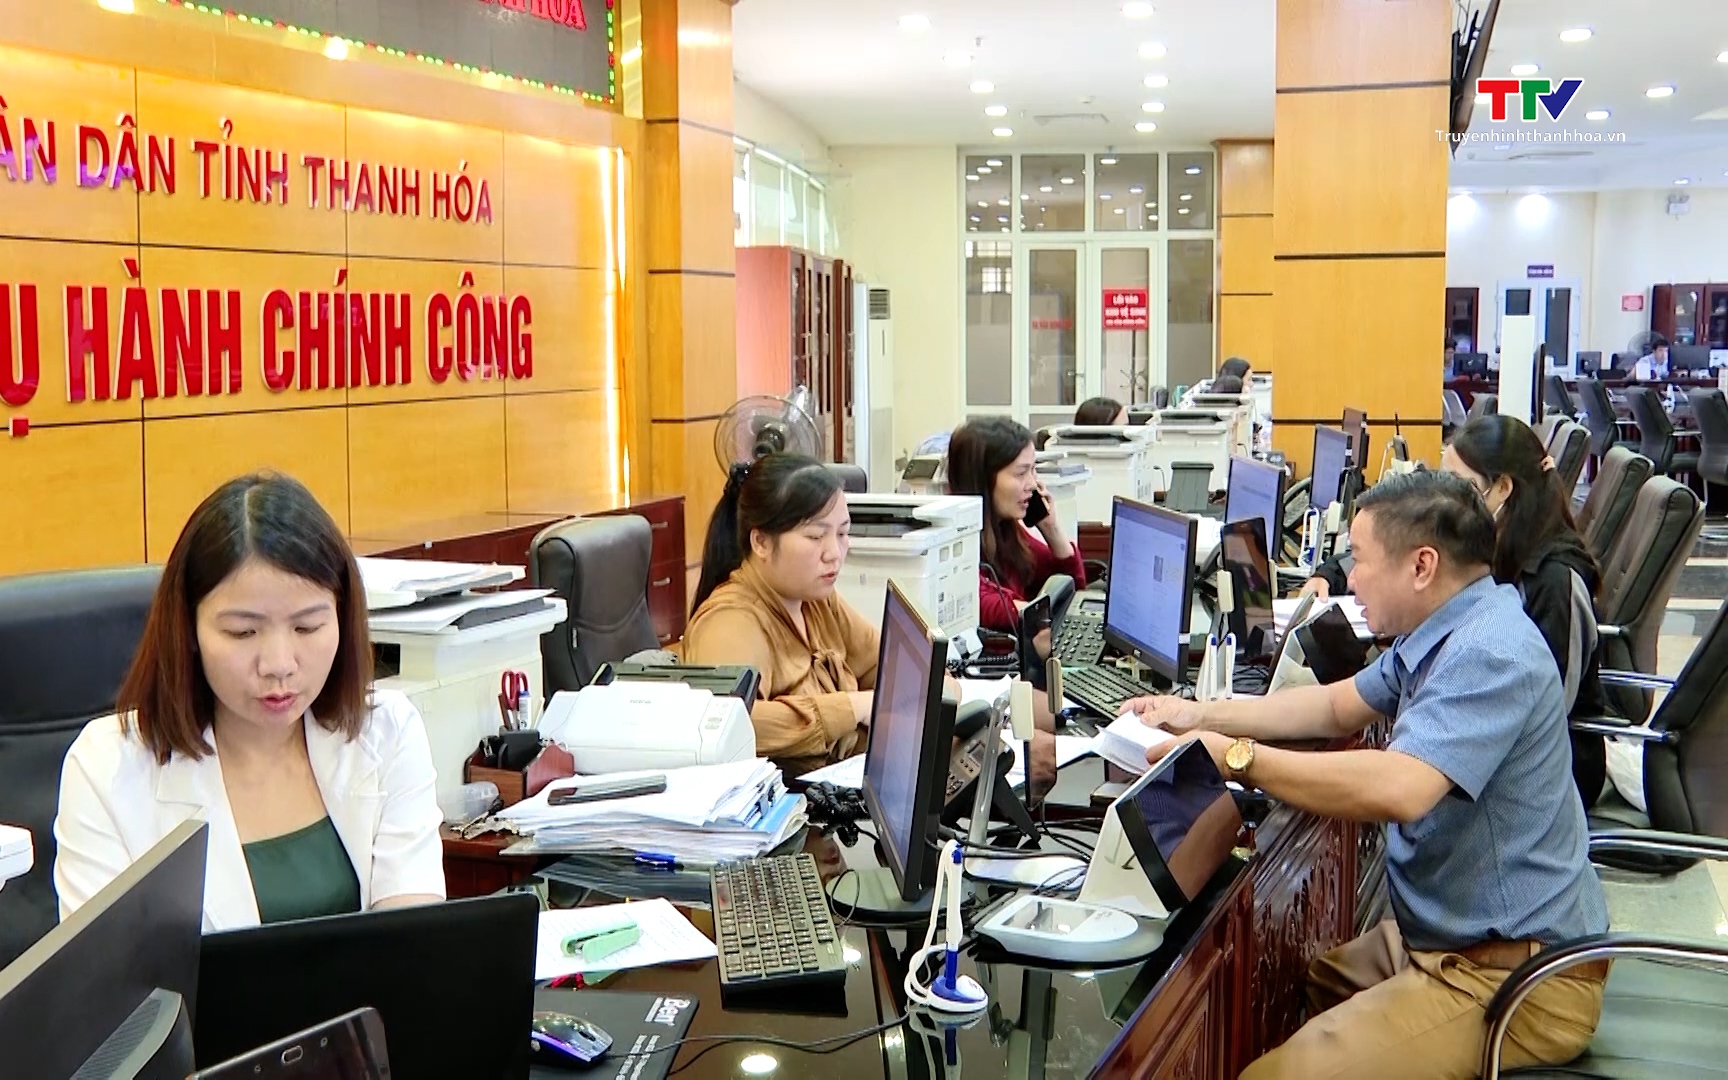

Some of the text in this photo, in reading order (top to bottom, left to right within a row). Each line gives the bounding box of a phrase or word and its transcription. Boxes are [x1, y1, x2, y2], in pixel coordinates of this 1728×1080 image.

[76, 113, 176, 196] DÂN
[191, 117, 288, 205] TỈNH
[300, 153, 420, 217] THANH
[430, 160, 493, 226] HÓA
[63, 257, 242, 404] HÀNH
[260, 268, 412, 393] CHÍNH
[425, 270, 533, 384] CÔNG
